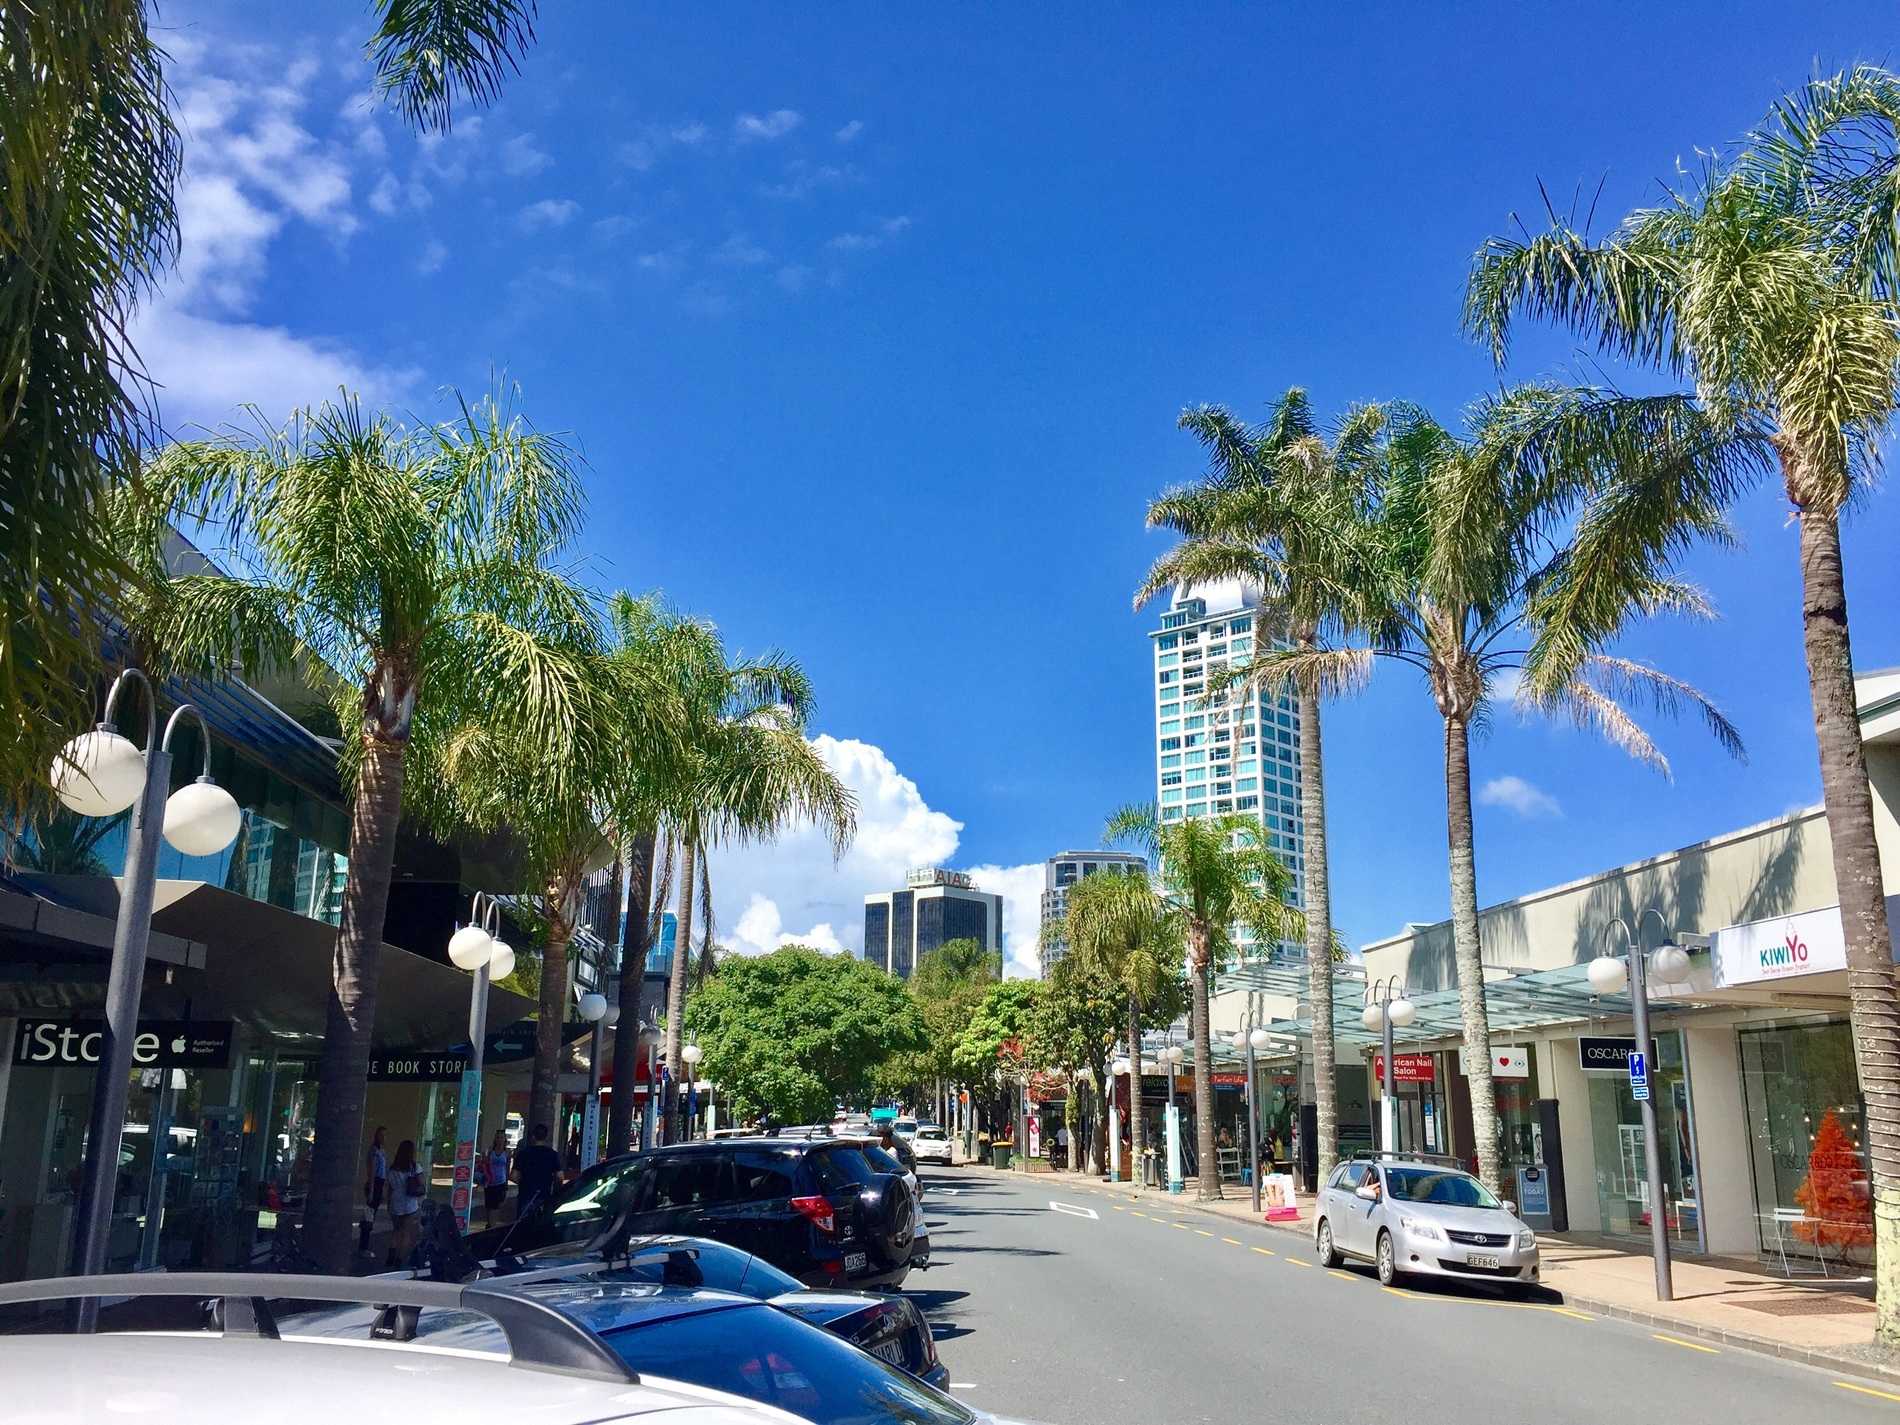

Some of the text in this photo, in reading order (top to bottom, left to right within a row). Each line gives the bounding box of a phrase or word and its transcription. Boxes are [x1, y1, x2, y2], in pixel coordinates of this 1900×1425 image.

[936, 869, 961, 885] AIA
[20, 1024, 160, 1062] iStoe
[387, 1060, 420, 1074] BOOK
[1376, 1058, 1433, 1067] Arican Nail
[1393, 1066, 1417, 1075] Salon
